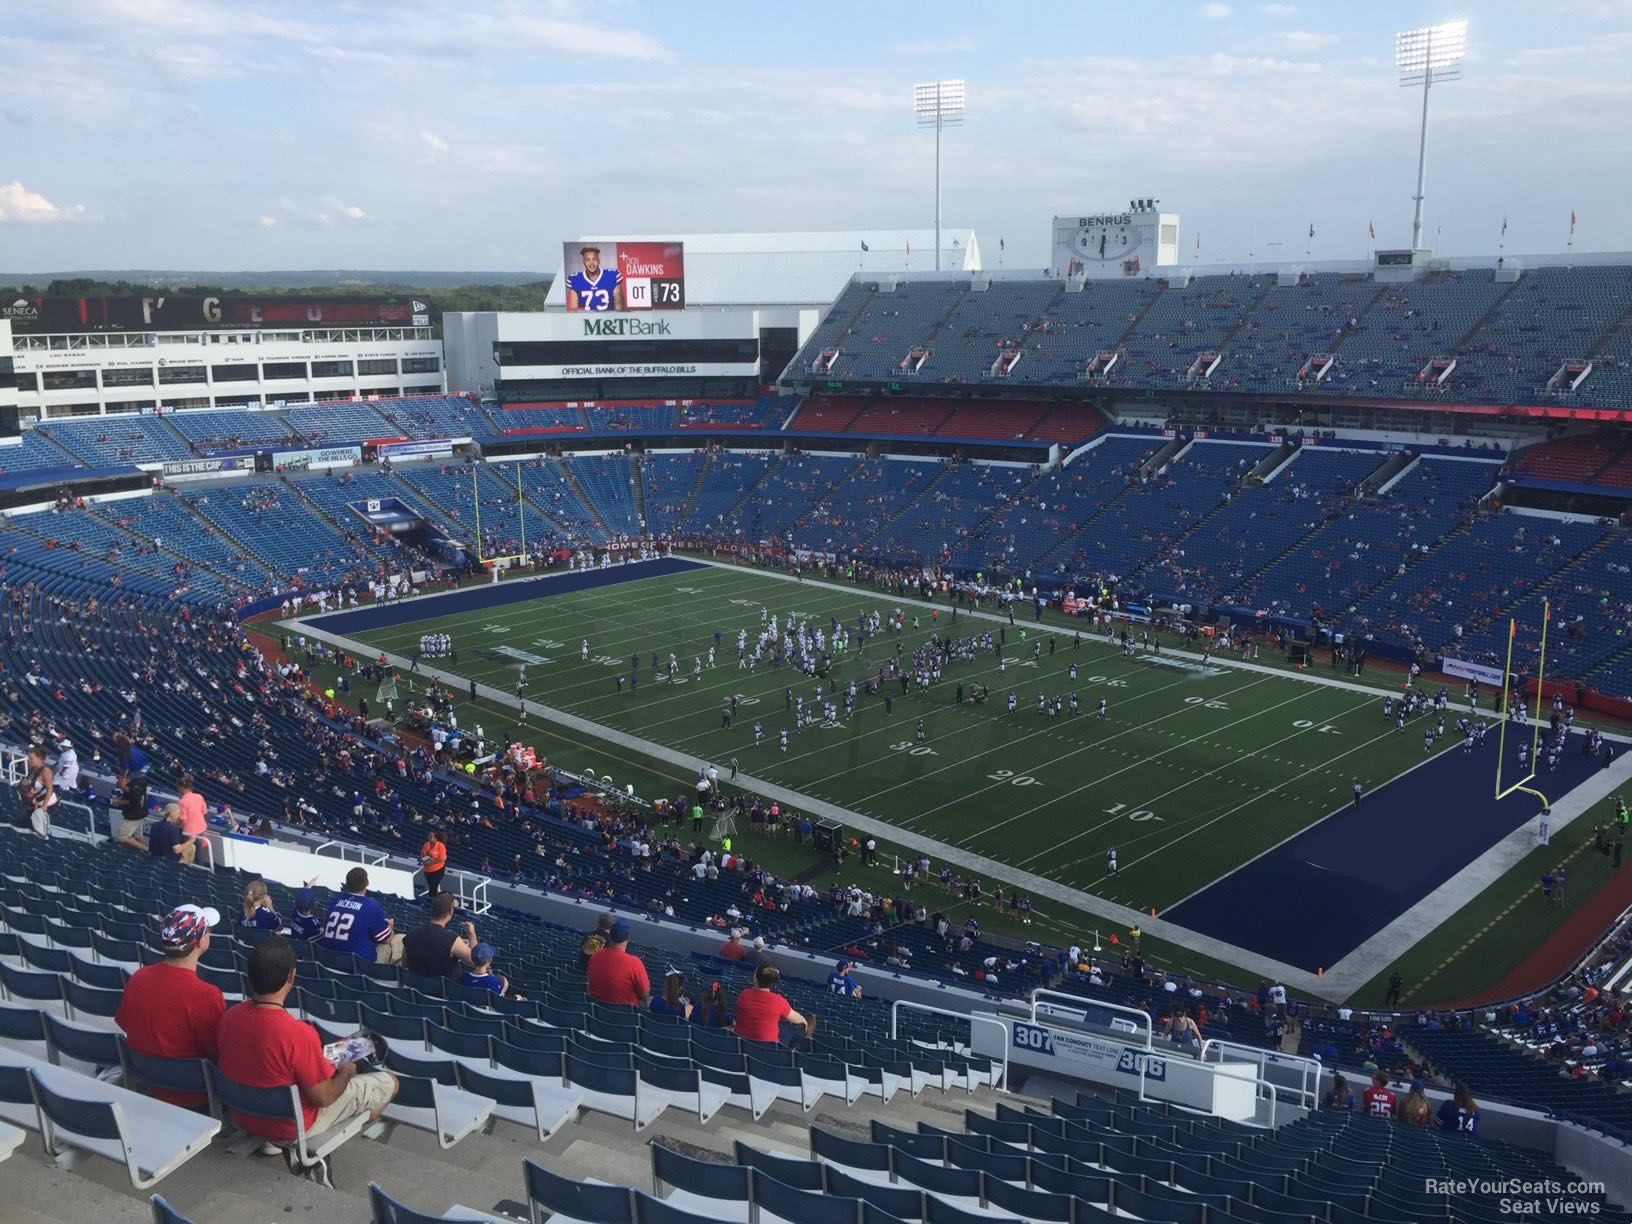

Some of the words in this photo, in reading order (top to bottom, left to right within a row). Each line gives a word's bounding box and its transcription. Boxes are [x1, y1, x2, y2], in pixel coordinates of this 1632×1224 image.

[1079, 215, 1132, 227] BENRUS
[1081, 237, 1087, 247] 9
[1121, 236, 1127, 246] 3
[626, 264, 664, 275] DAWKINS
[632, 286, 646, 300] OT
[660, 282, 680, 302] 73
[581, 289, 609, 311] 73
[2, 307, 38, 315] SENECA
[562, 368, 594, 376] OFFICIAL
[595, 367, 615, 375] BANK
[629, 366, 643, 374] THE
[644, 366, 676, 374] BUFFALO
[165, 463, 182, 474] THIS
[182, 462, 191, 473] IS
[191, 461, 206, 472] THE
[206, 460, 222, 471] CAP
[661, 540, 686, 549] THE
[890, 741, 934, 756] 30
[987, 769, 1036, 787] 20
[1102, 802, 1155, 822] 10
[335, 899, 363, 911] JACKSON
[324, 911, 355, 941] 22
[1015, 1026, 1051, 1051] 307
[1066, 1037, 1092, 1049] CONDUCT
[1120, 1050, 1164, 1077] 306
[1370, 1102, 1391, 1118] 25
[1457, 1115, 1474, 1132] 14
